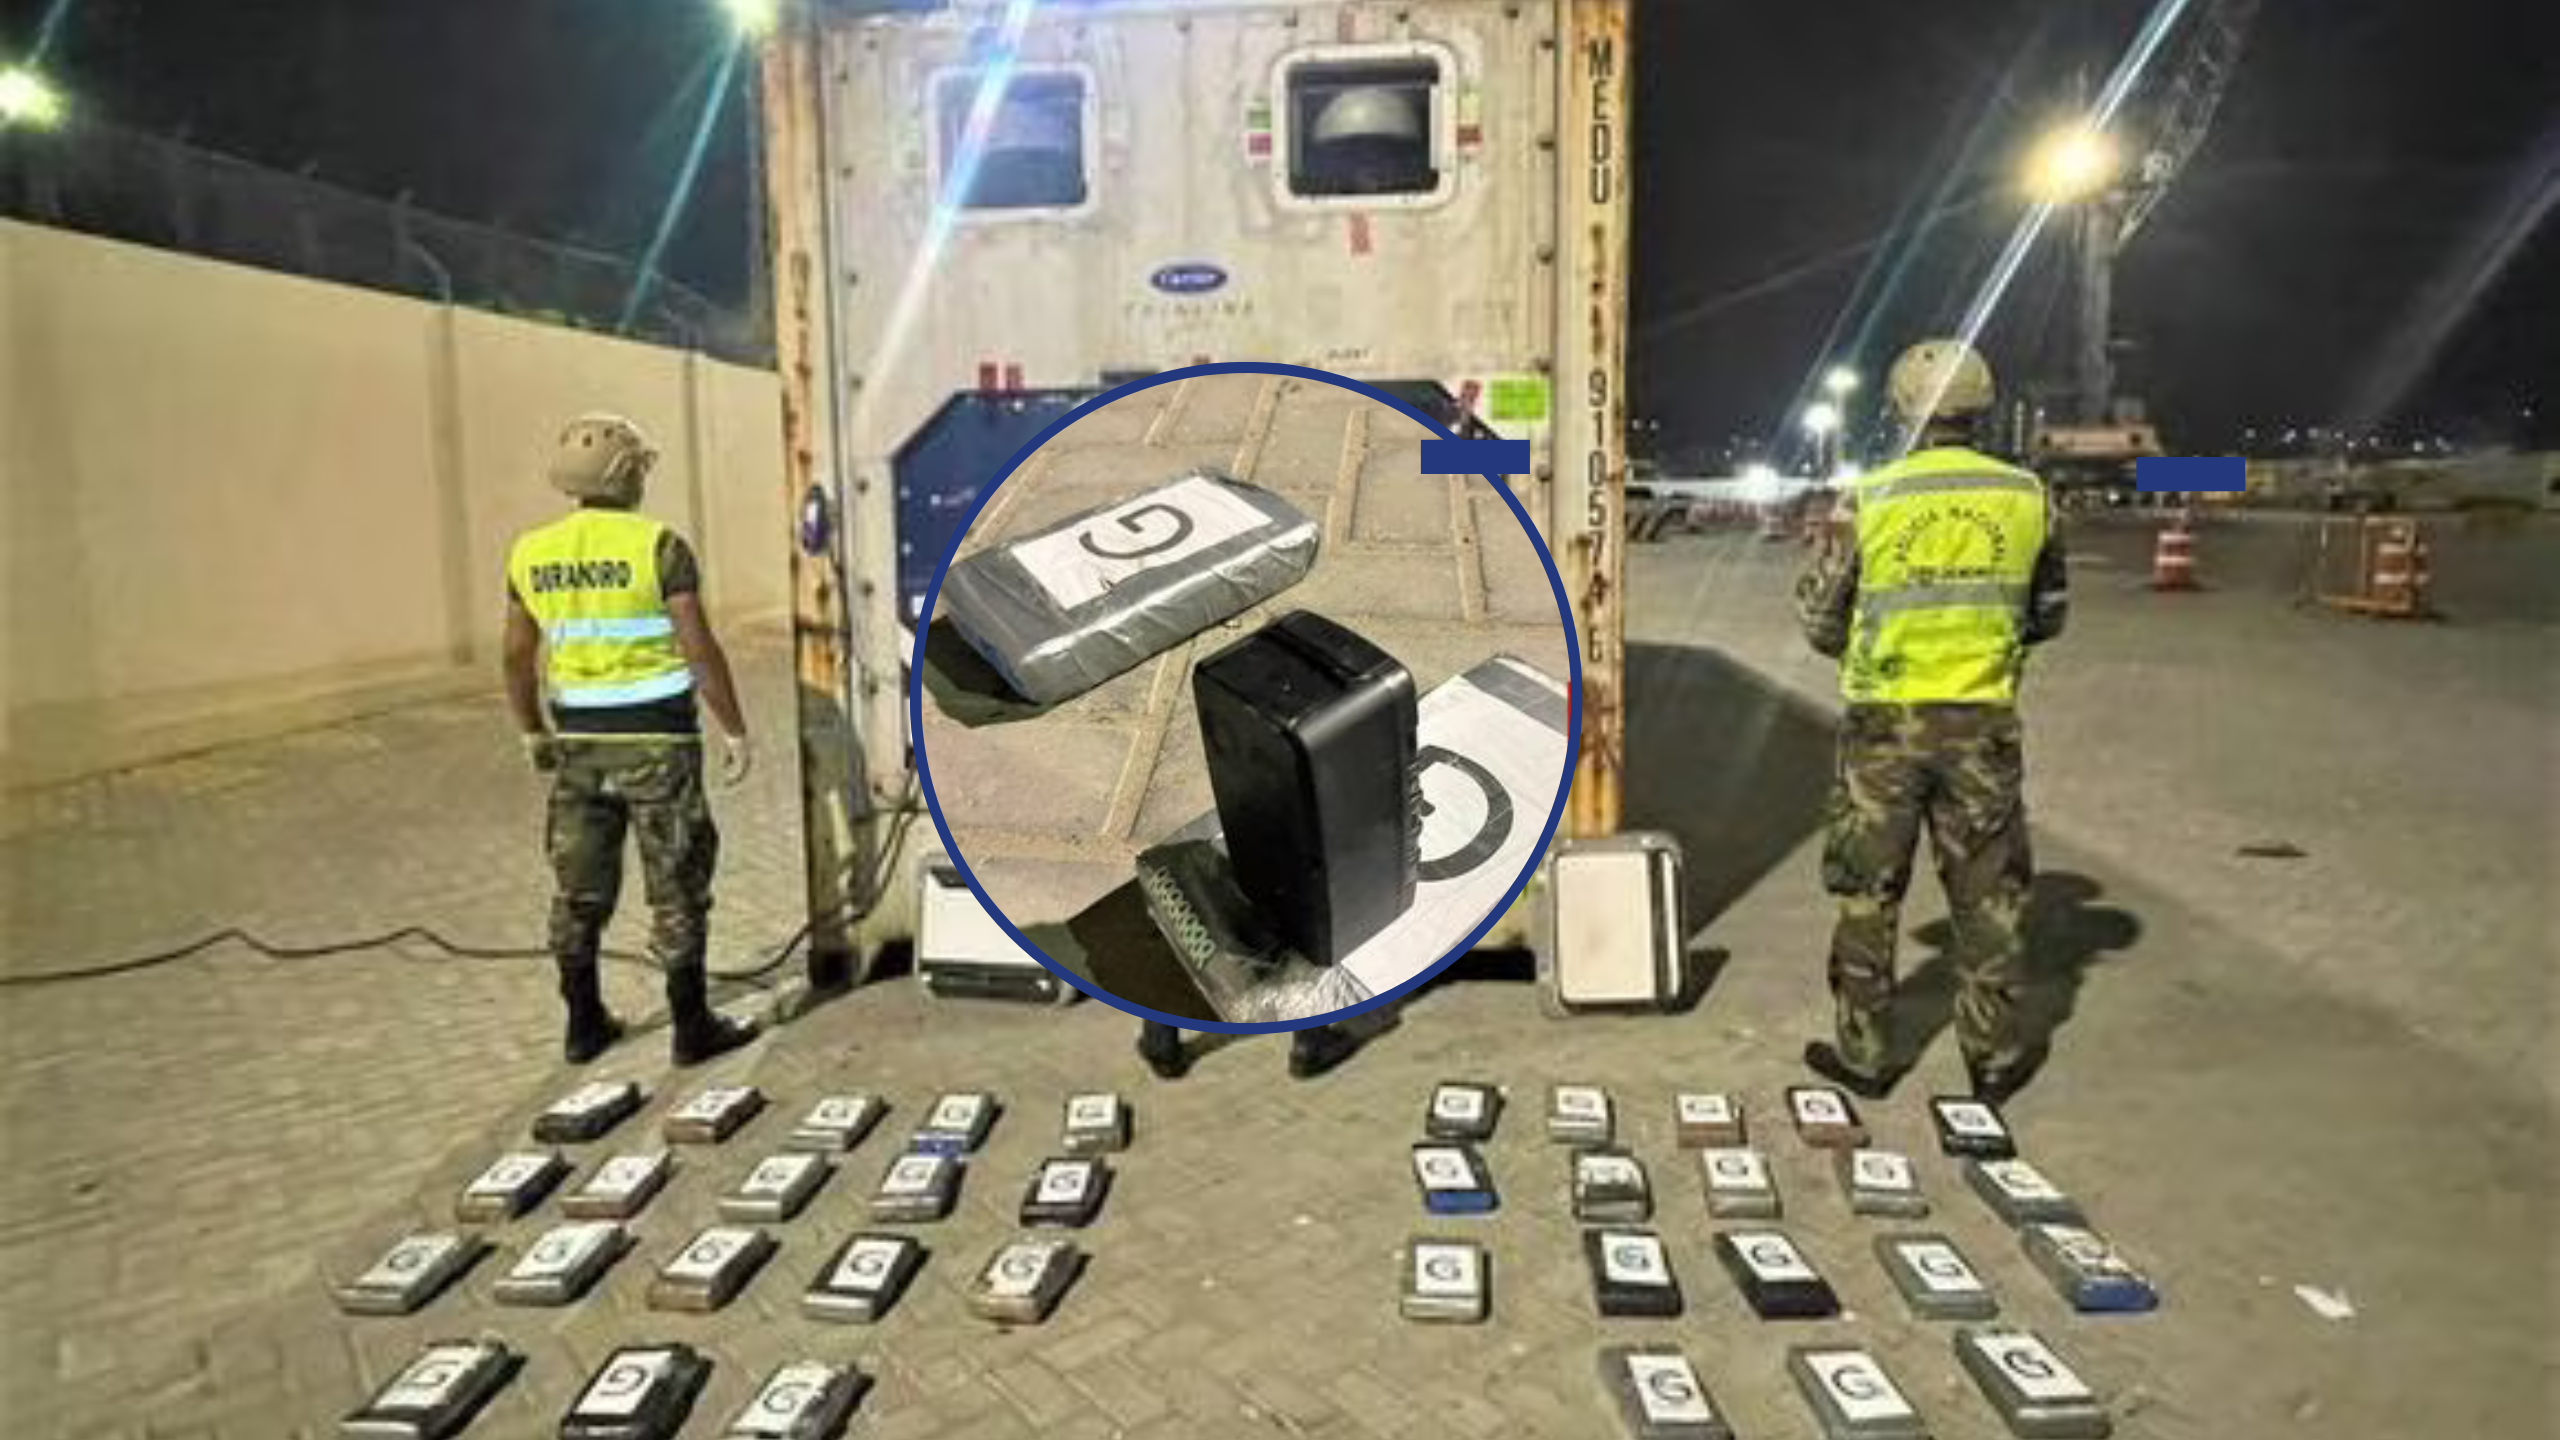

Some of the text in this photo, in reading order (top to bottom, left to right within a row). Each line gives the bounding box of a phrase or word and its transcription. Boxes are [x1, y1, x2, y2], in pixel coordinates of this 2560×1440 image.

[1590, 38, 1612, 204] MEDU
[1080, 503, 1194, 560] G
[1716, 1155, 1749, 1177] G
[1048, 1171, 1080, 1192] G
[850, 1249, 886, 1276] G
[1002, 1253, 1041, 1279] G
[1425, 1253, 1463, 1282] G
[1614, 1244, 1651, 1271] G
[1751, 1242, 1794, 1268] G
[1918, 1252, 1963, 1278] G
[2003, 1348, 2055, 1380] G
[1650, 1369, 1694, 1401] G
[1830, 1364, 1885, 1400] G
[763, 1381, 812, 1414] G
